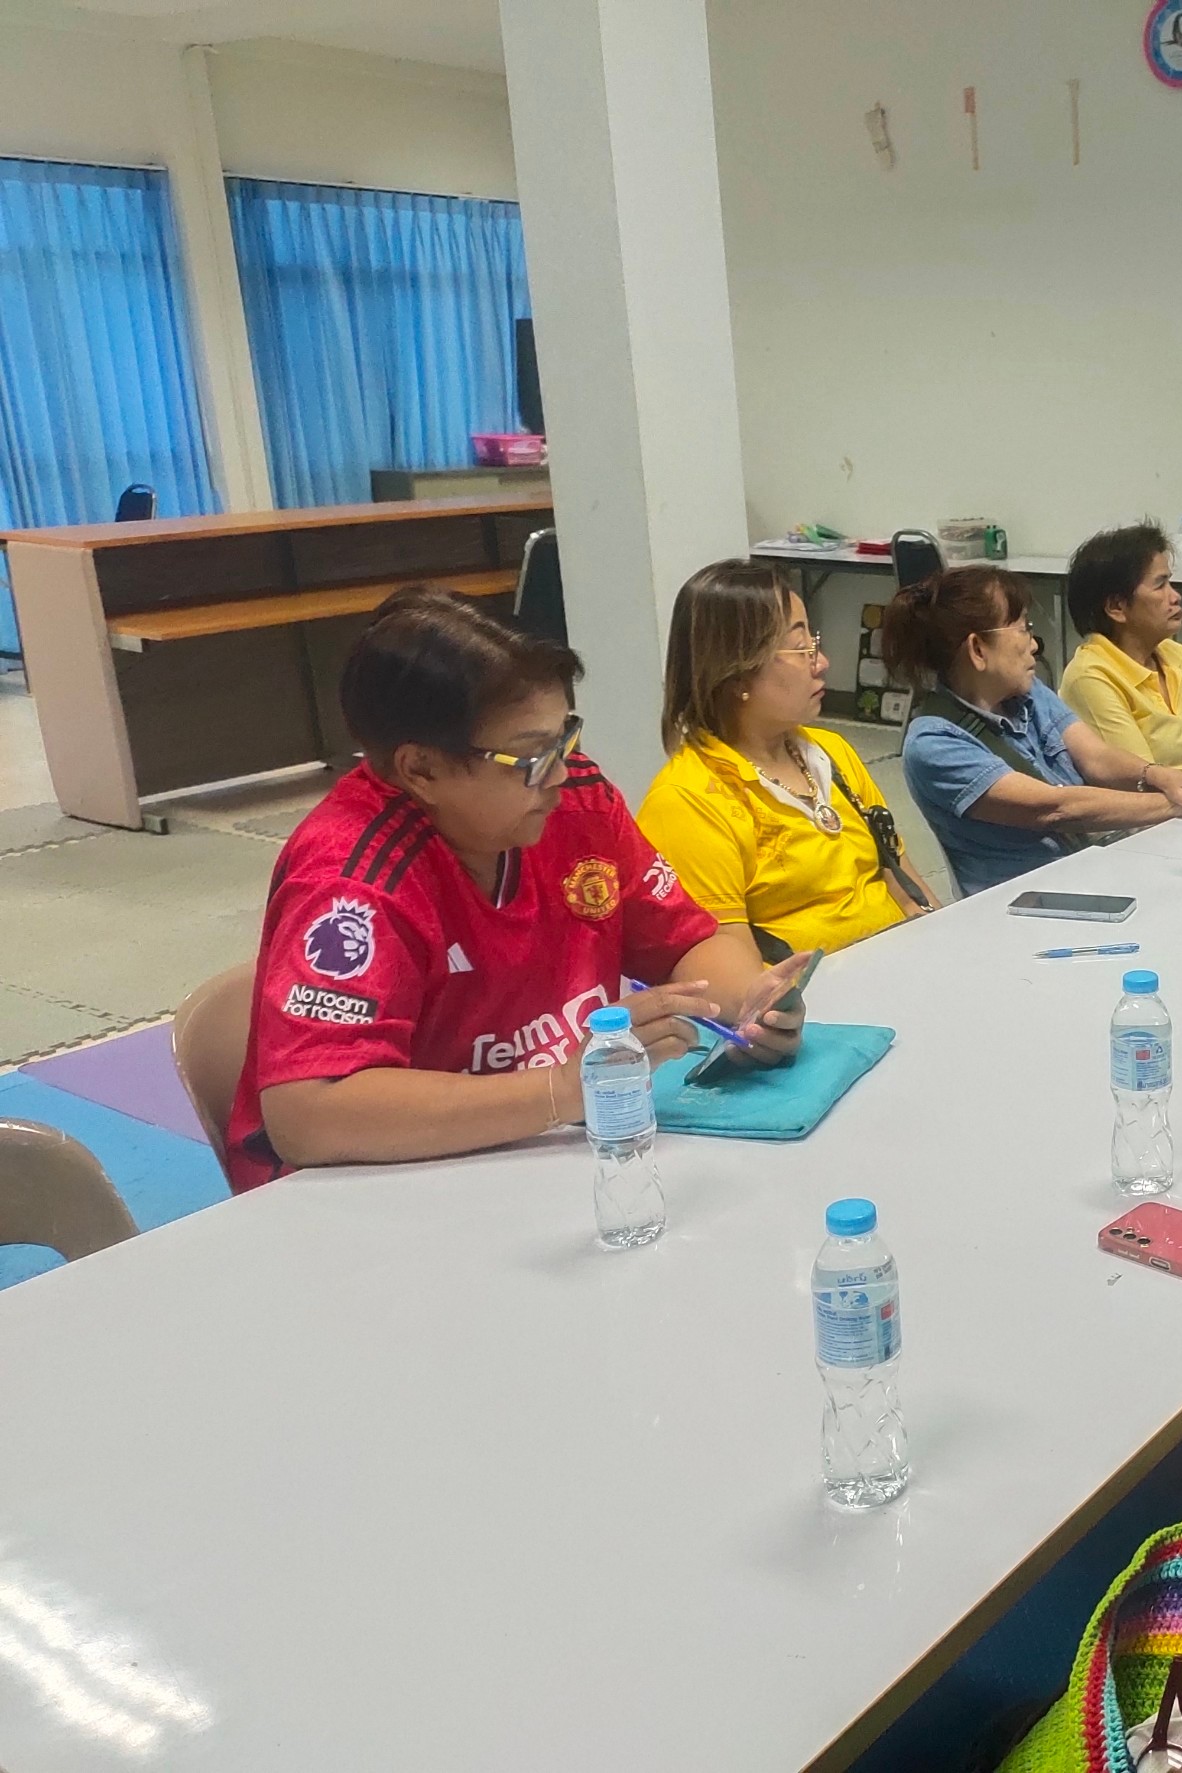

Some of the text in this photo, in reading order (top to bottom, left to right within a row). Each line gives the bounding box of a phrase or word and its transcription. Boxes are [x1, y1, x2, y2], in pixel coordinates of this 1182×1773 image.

[568, 862, 617, 889] MANCHESTER
[582, 899, 617, 915] UNITED
[288, 984, 369, 1014] No room
